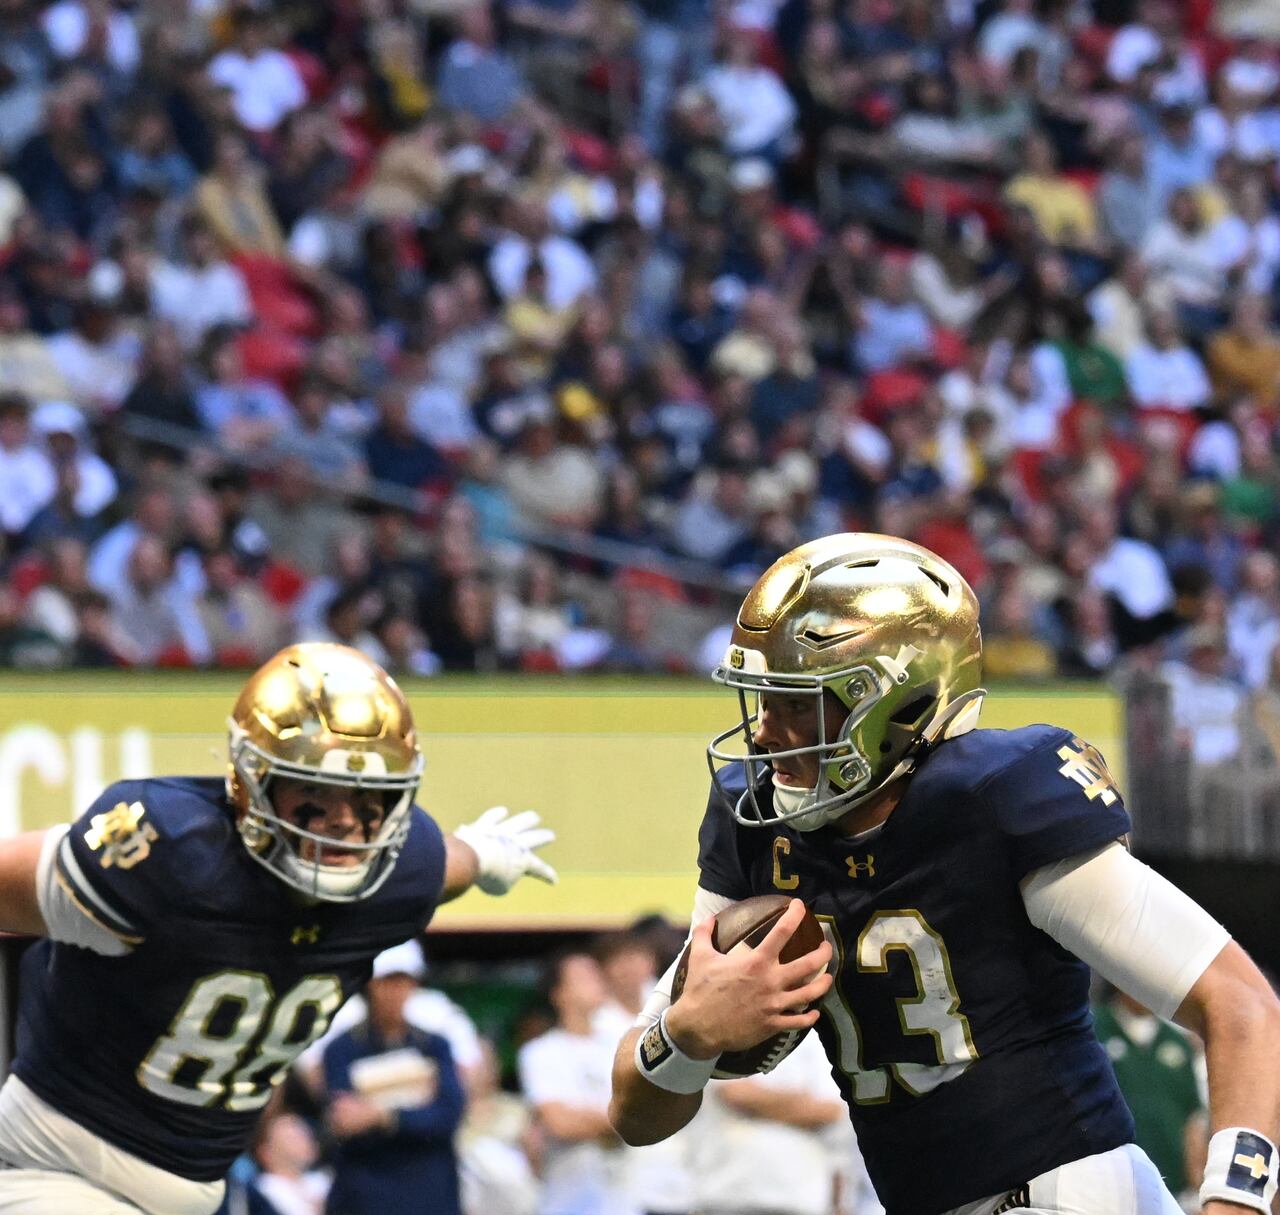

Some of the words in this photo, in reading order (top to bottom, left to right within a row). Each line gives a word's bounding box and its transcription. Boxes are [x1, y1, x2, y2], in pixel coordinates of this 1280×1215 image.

[772, 835, 800, 890] C
[135, 966, 344, 1112] 88
[813, 908, 981, 1106] 13
